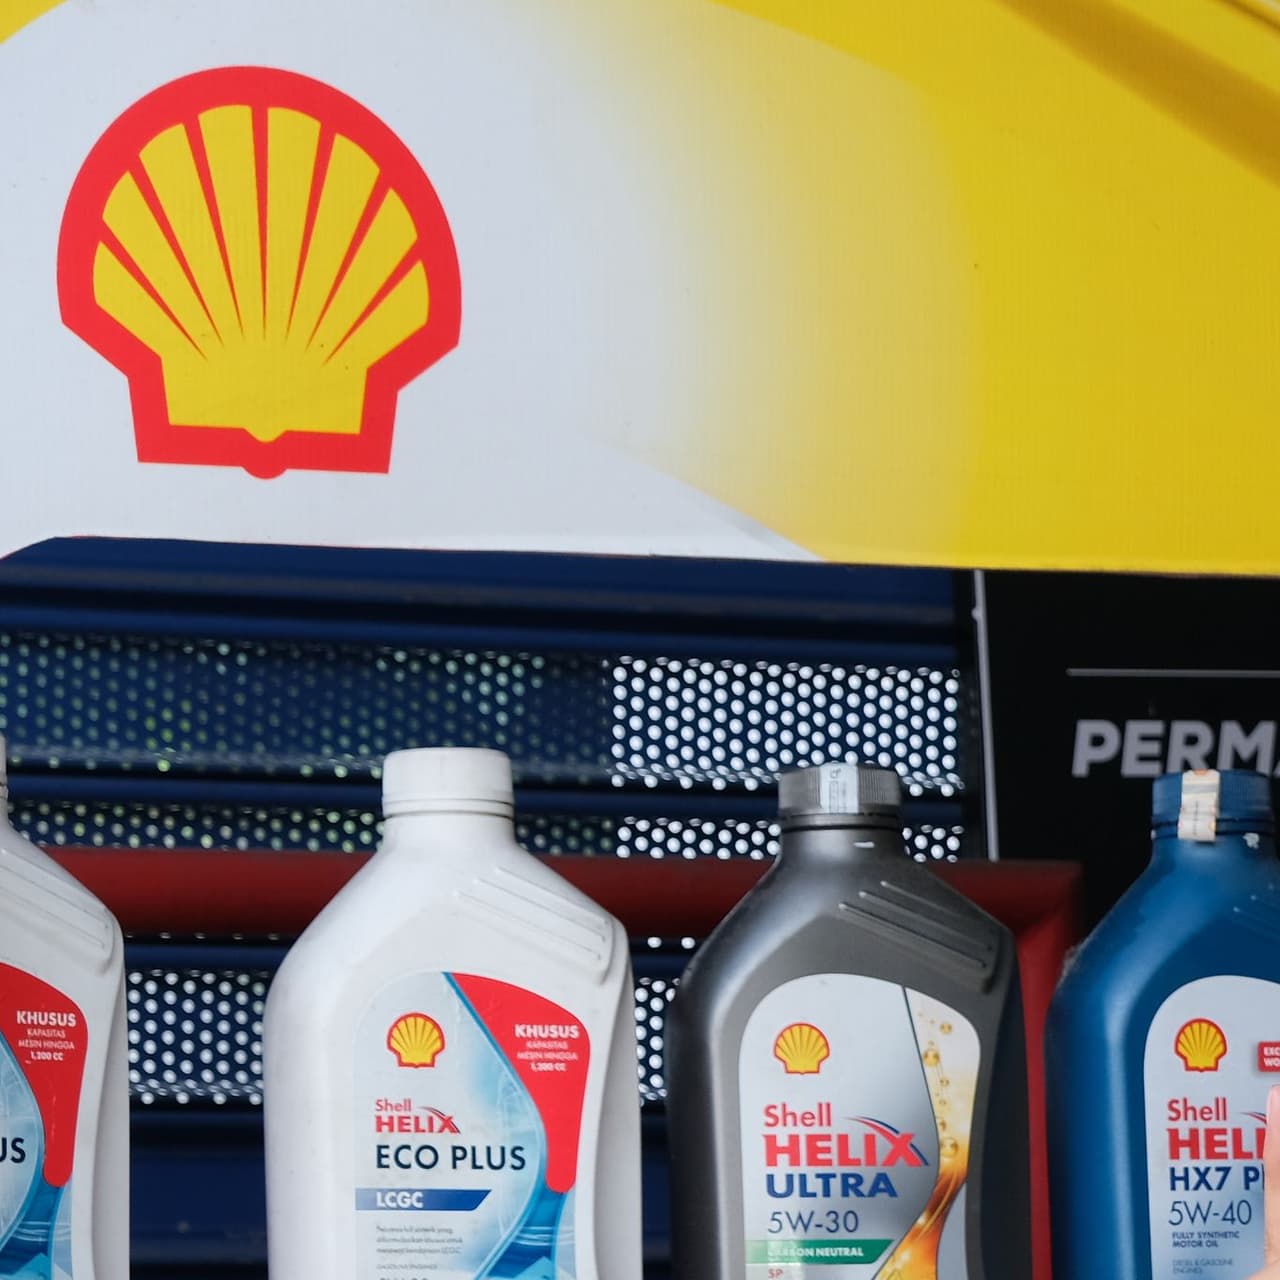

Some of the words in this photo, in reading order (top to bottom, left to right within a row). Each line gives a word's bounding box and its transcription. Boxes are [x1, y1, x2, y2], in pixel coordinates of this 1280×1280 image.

[16, 1010, 77, 1027] KHUSUS
[515, 1024, 579, 1039] KHUSUS
[375, 1098, 412, 1112] Shell
[763, 1102, 832, 1128] Shell
[1167, 1097, 1227, 1121] Shell
[374, 1112, 461, 1134] HELIX
[762, 1128, 930, 1168] HELIX
[1167, 1128, 1267, 1160] HELI
[376, 1144, 439, 1170] ECO
[452, 1145, 526, 1170] PLUS
[766, 1172, 898, 1198] ULTRA
[1169, 1166, 1232, 1191] HX7
[376, 1191, 424, 1209] LCGC
[767, 1210, 859, 1234] 5W-30
[1169, 1200, 1252, 1226] 5W-40
[816, 1247, 864, 1257] NEUTRAL
[768, 1269, 784, 1279] SP
